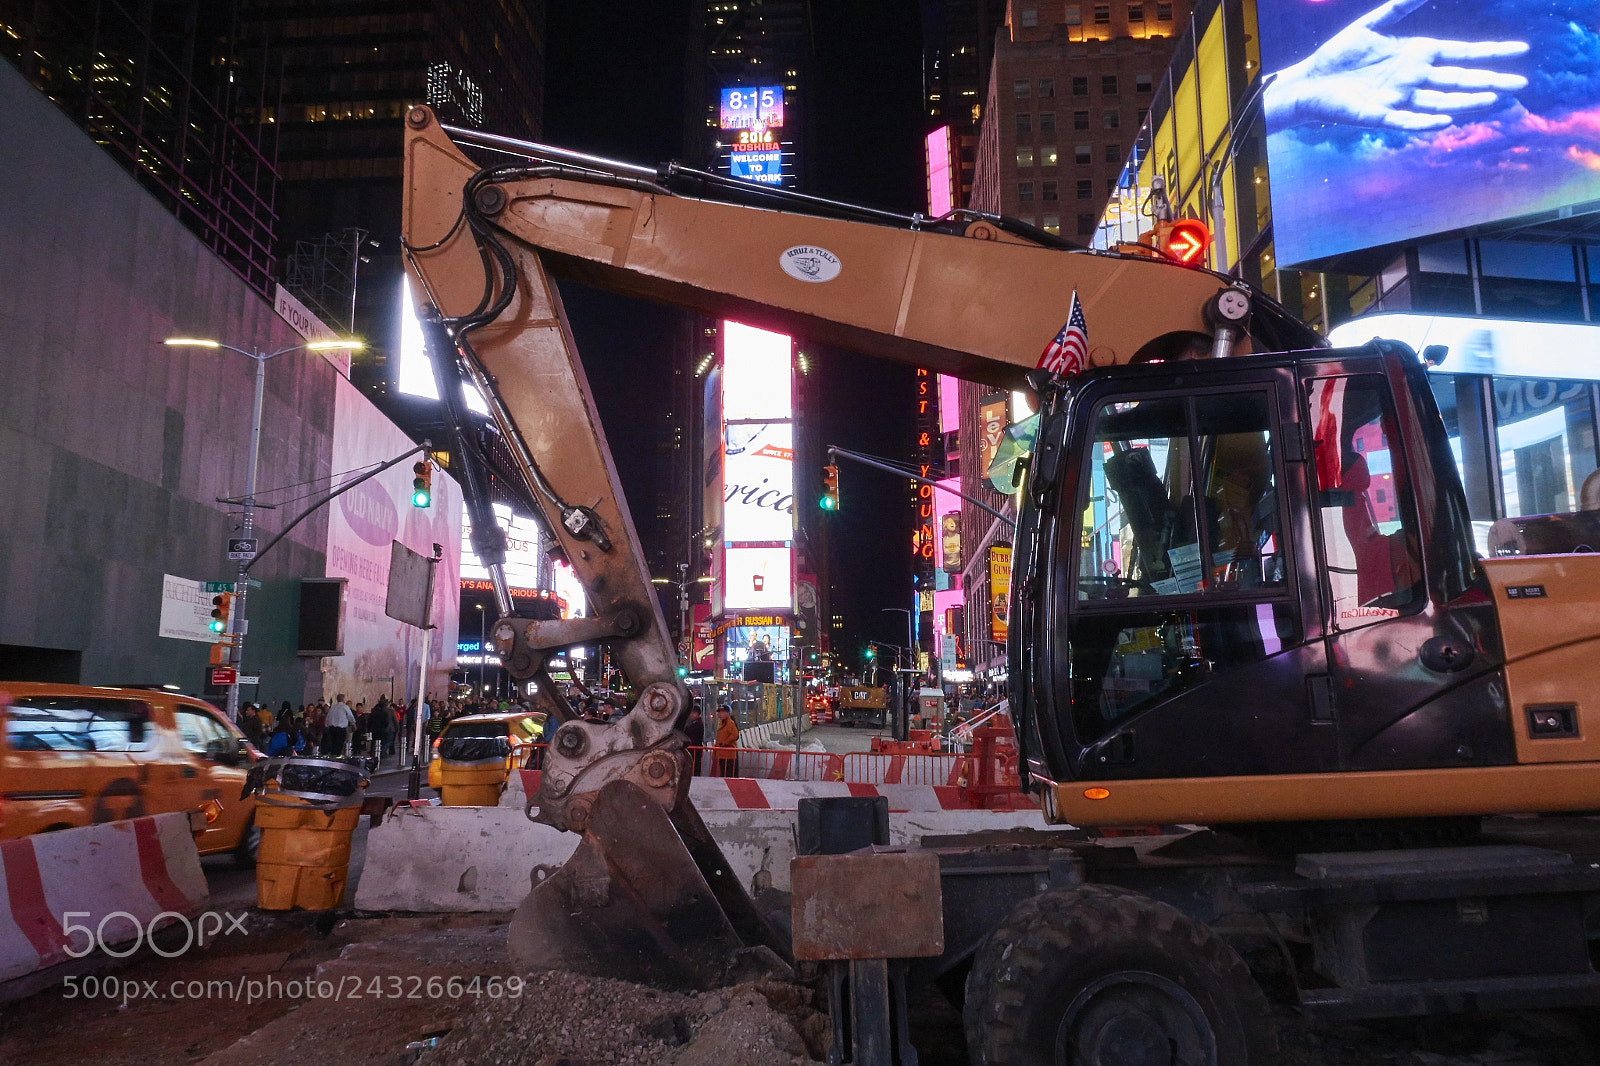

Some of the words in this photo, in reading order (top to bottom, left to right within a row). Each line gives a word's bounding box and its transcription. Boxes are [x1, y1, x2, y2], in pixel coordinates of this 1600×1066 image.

[729, 90, 774, 110] 8:15
[740, 131, 772, 144] 2016
[732, 142, 780, 152] TOSHIBA
[732, 153, 780, 162] WELCOME
[749, 164, 763, 172] TO
[755, 174, 781, 182] YORK
[815, 248, 838, 264] TULLY
[280, 298, 287, 316] IF
[288, 304, 309, 335] YOUR
[217, 583, 227, 591] 45
[745, 615, 773, 626] RUSSIAN
[854, 691, 868, 700] CAT
